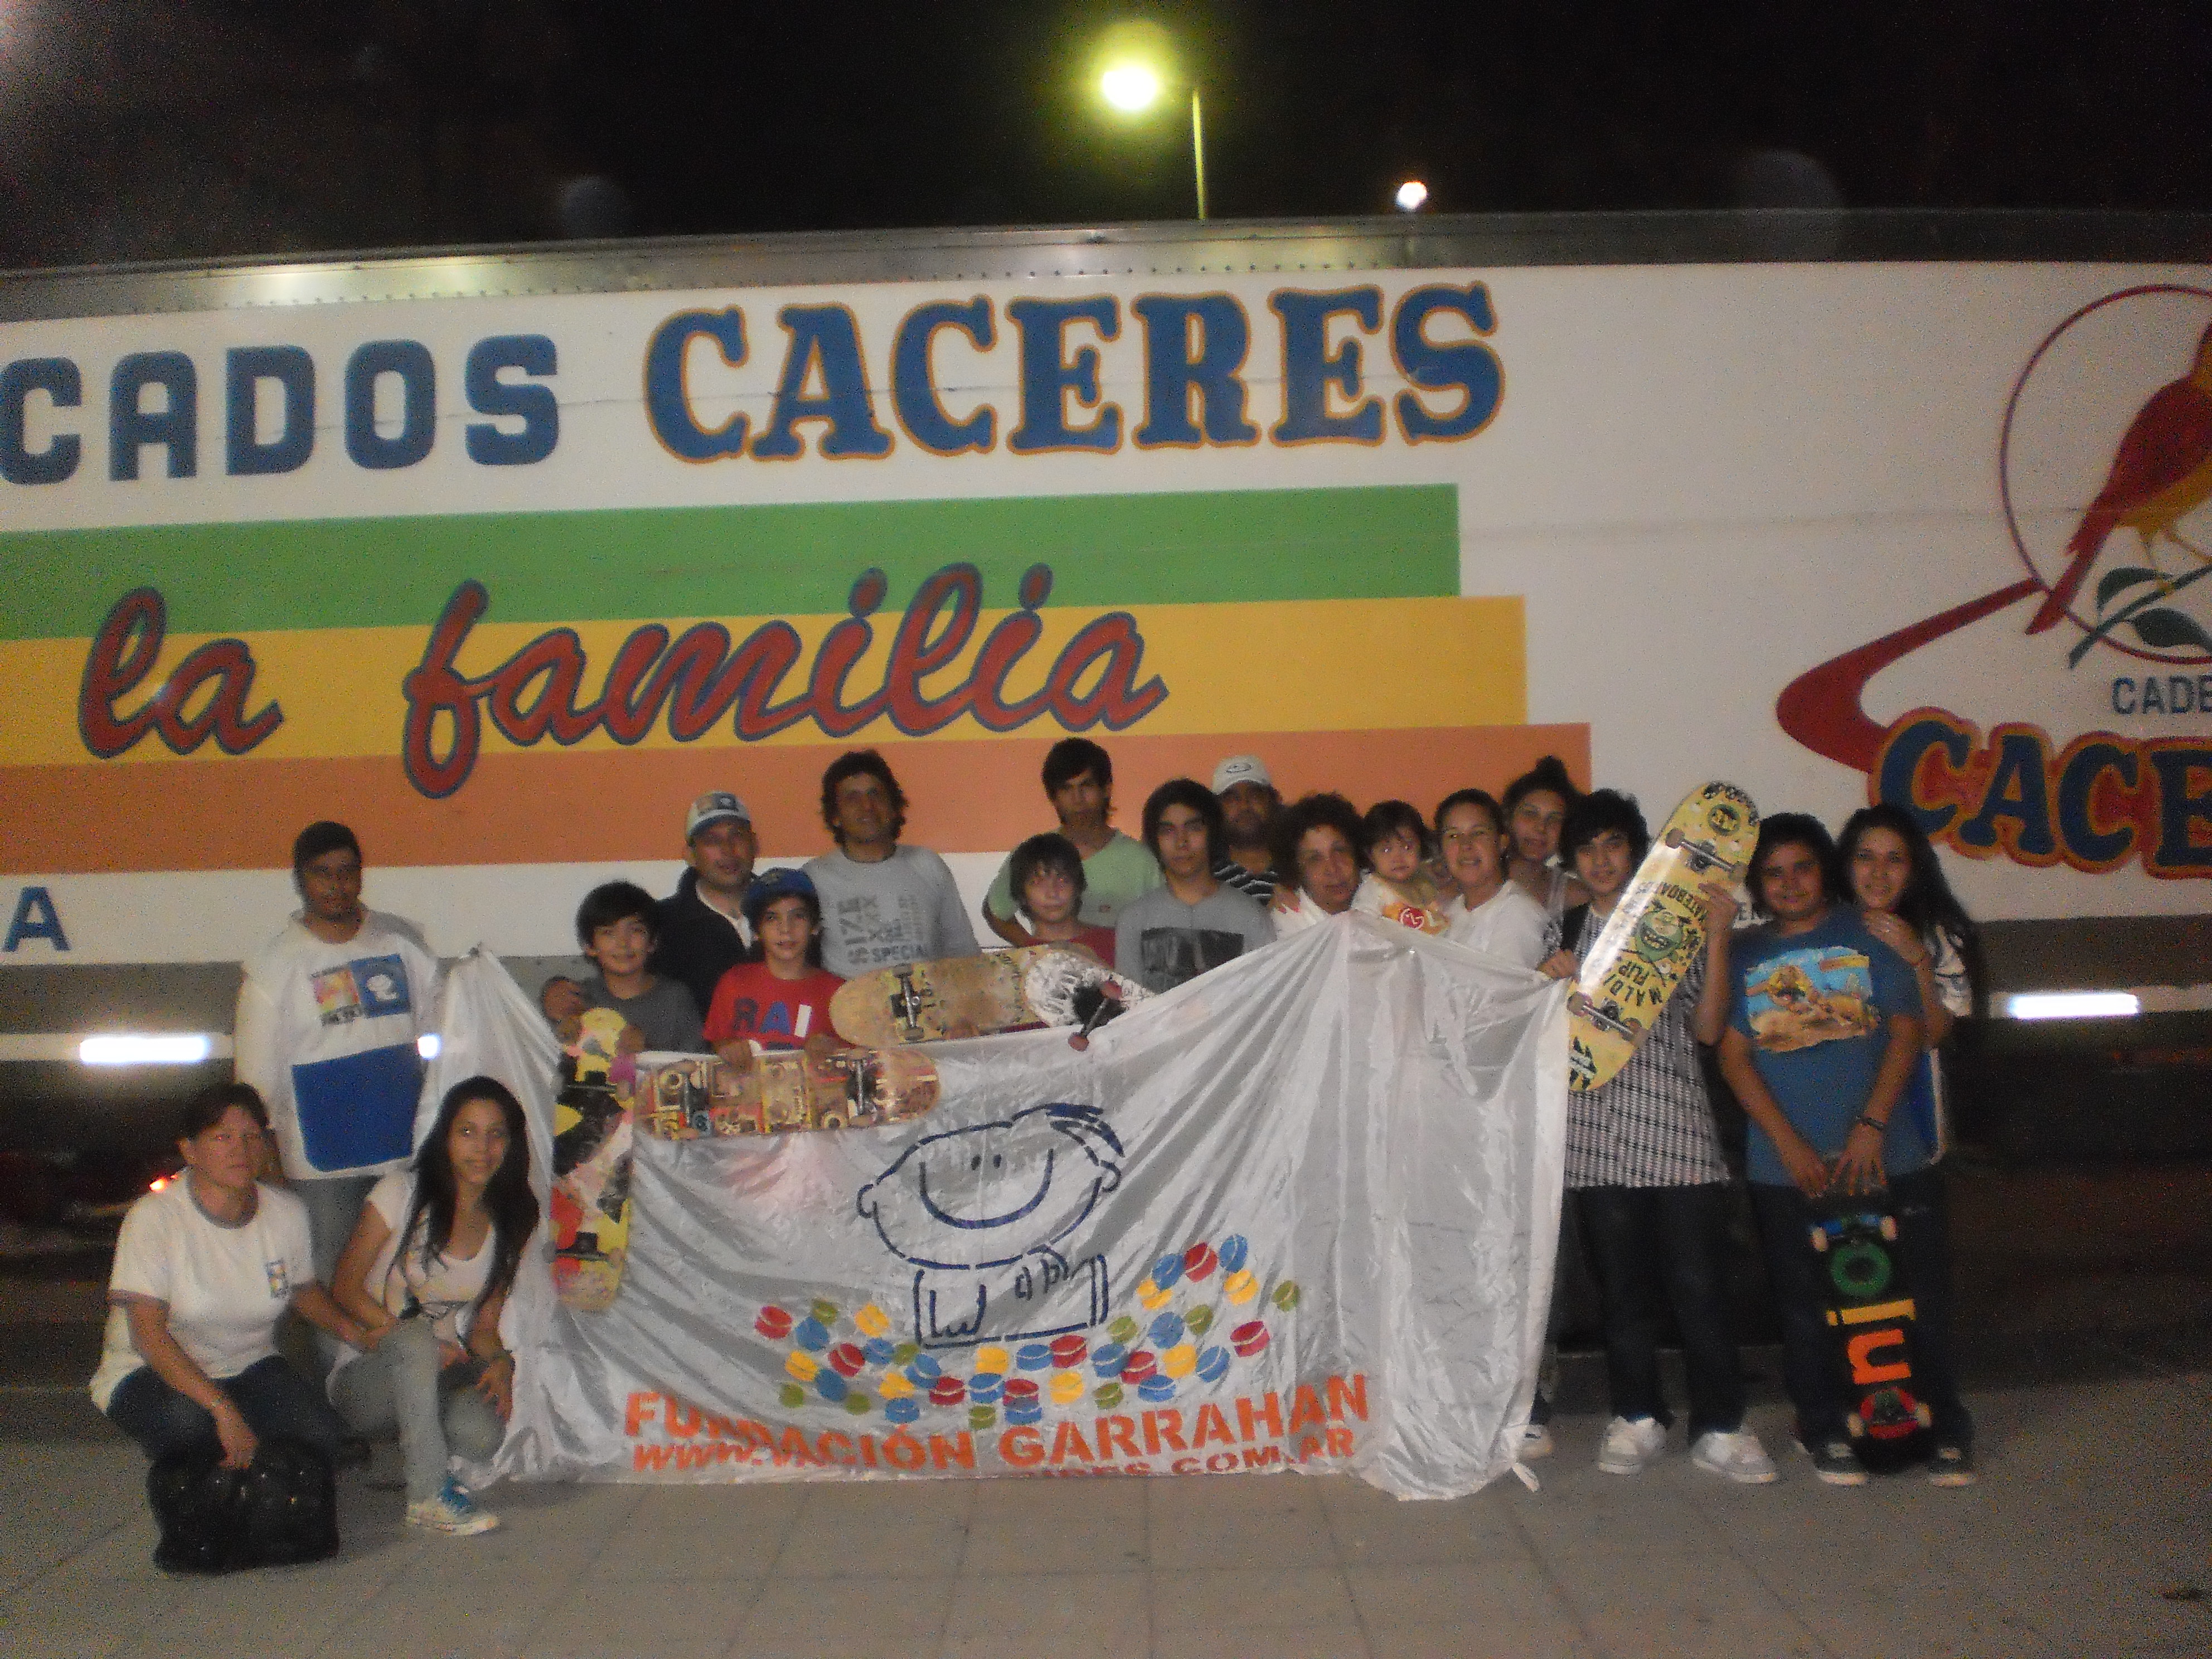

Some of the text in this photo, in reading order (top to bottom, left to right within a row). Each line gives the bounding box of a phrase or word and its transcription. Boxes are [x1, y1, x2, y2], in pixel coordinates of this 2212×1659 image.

[0, 280, 1506, 485] CADOS CACERES
[78, 561, 1170, 799] la familia
[2, 886, 71, 952] A
[998, 1373, 1368, 1467] GARRAHAN
